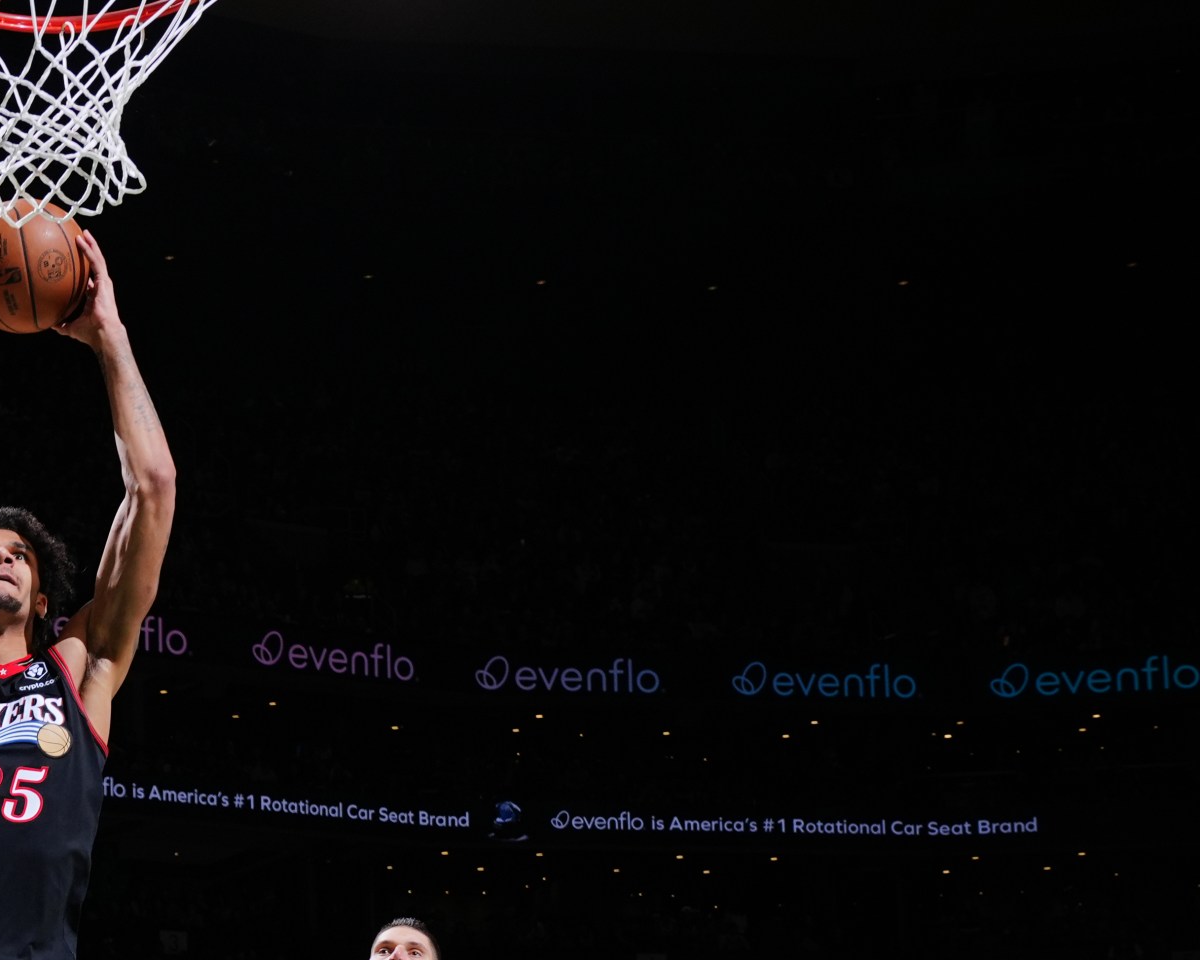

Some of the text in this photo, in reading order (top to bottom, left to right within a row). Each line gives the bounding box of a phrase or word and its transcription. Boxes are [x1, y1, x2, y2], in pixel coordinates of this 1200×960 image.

[53, 616, 188, 655] eflo
[288, 643, 414, 681] evenflo
[514, 658, 660, 694] evenflo
[1035, 655, 1200, 696] evenflo
[19, 677, 61, 692] crypto.co
[772, 663, 916, 699] evenflo
[132, 782, 145, 800] is
[148, 784, 230, 808] America's
[234, 793, 255, 810] #1
[260, 795, 343, 818] Rotational
[347, 804, 375, 821] Car
[379, 806, 415, 825] Seat
[419, 810, 470, 828] Brand
[572, 811, 1038, 836] evenflo is America's #1 Rotational Car Seat Brand
